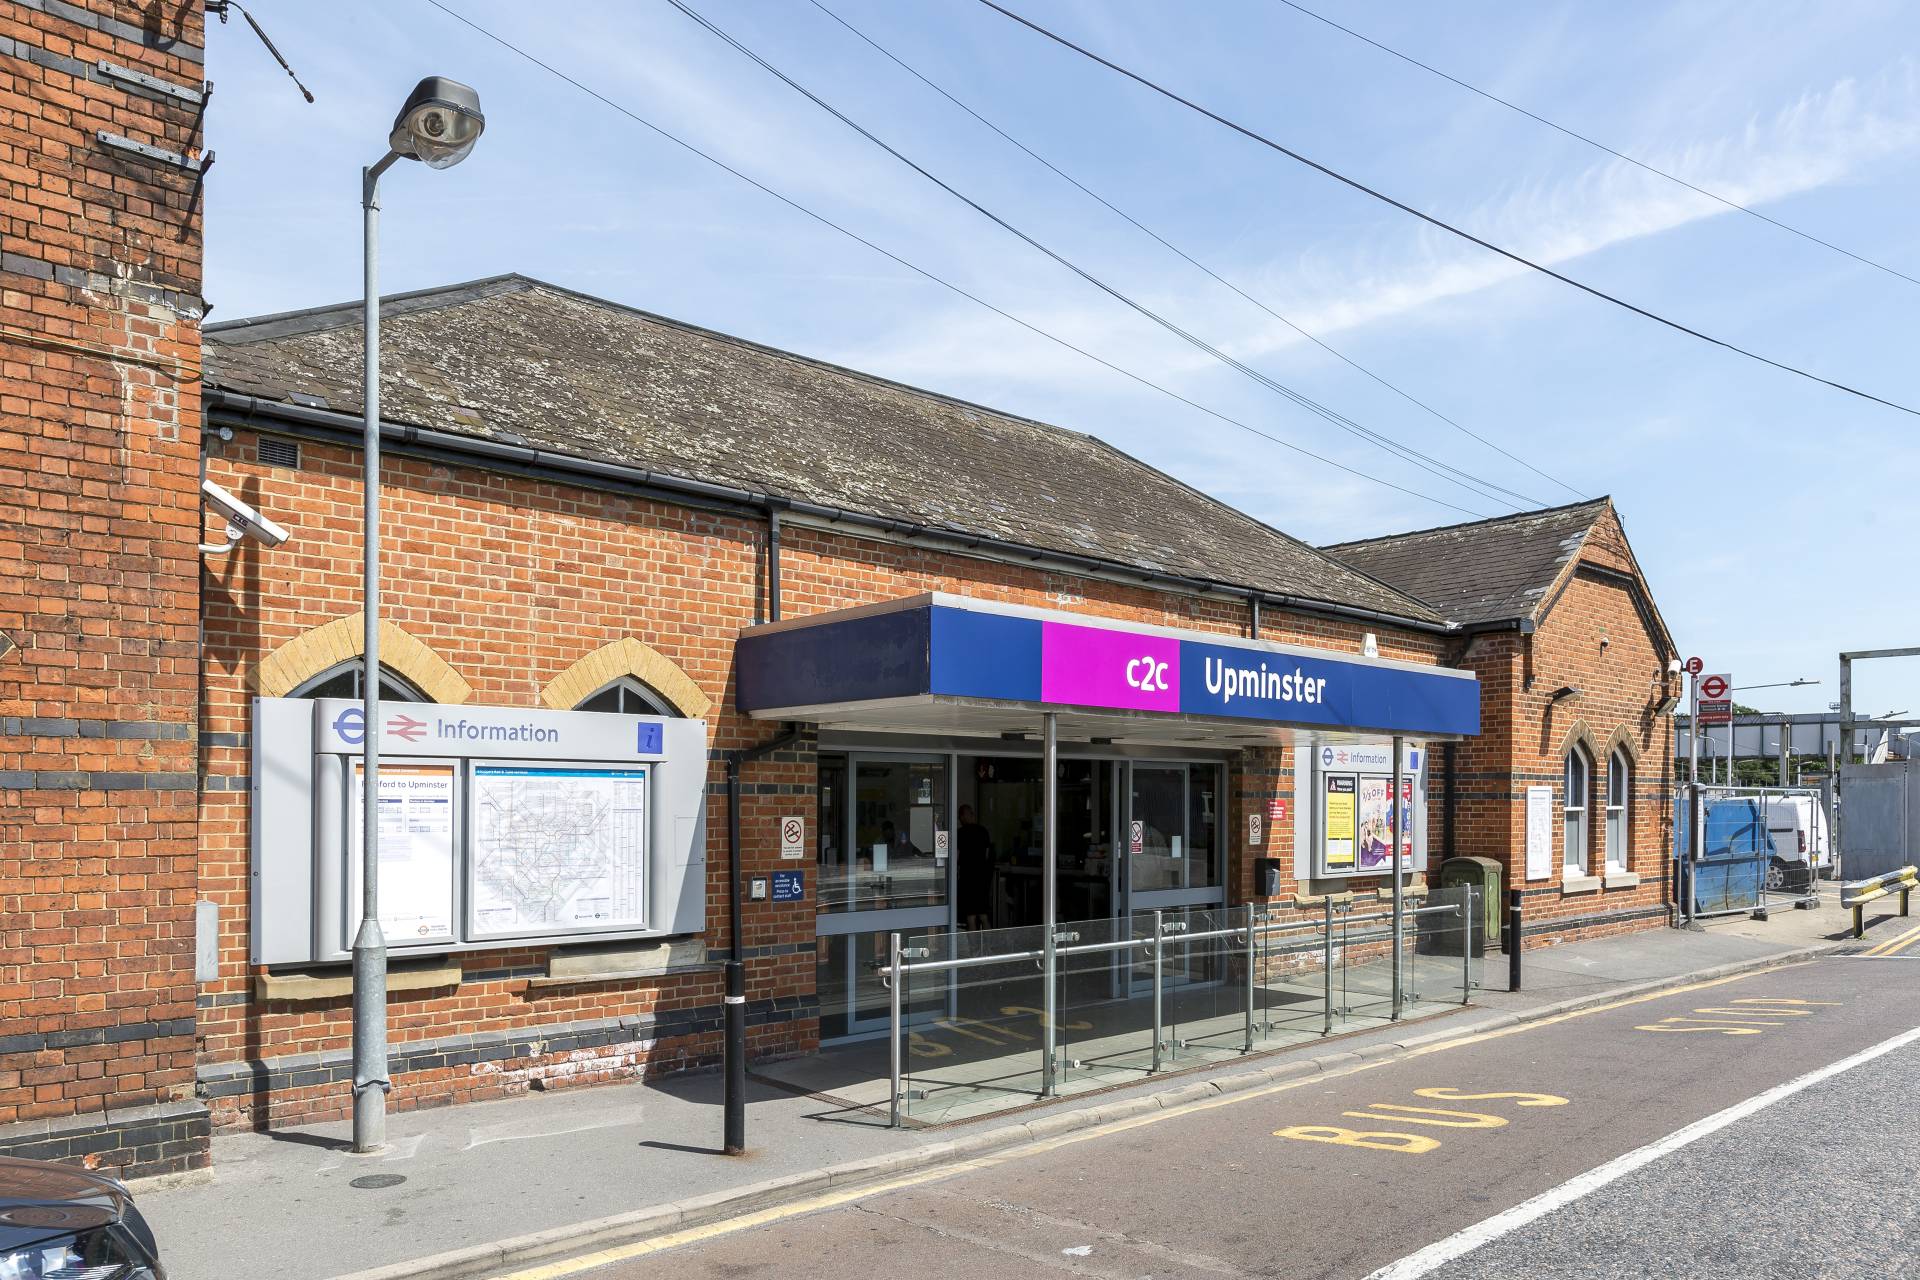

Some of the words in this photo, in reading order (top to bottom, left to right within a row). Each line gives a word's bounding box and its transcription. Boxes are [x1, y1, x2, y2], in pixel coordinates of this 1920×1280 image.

[1126, 656, 1169, 692] c2c
[1205, 656, 1327, 704] Upminster
[1689, 660, 1699, 673] E
[437, 719, 559, 743] Information
[1351, 751, 1387, 765] Information
[408, 781, 448, 789] Upminster
[1634, 998, 1844, 1035] STOP
[1272, 1087, 1570, 1154] BUS
